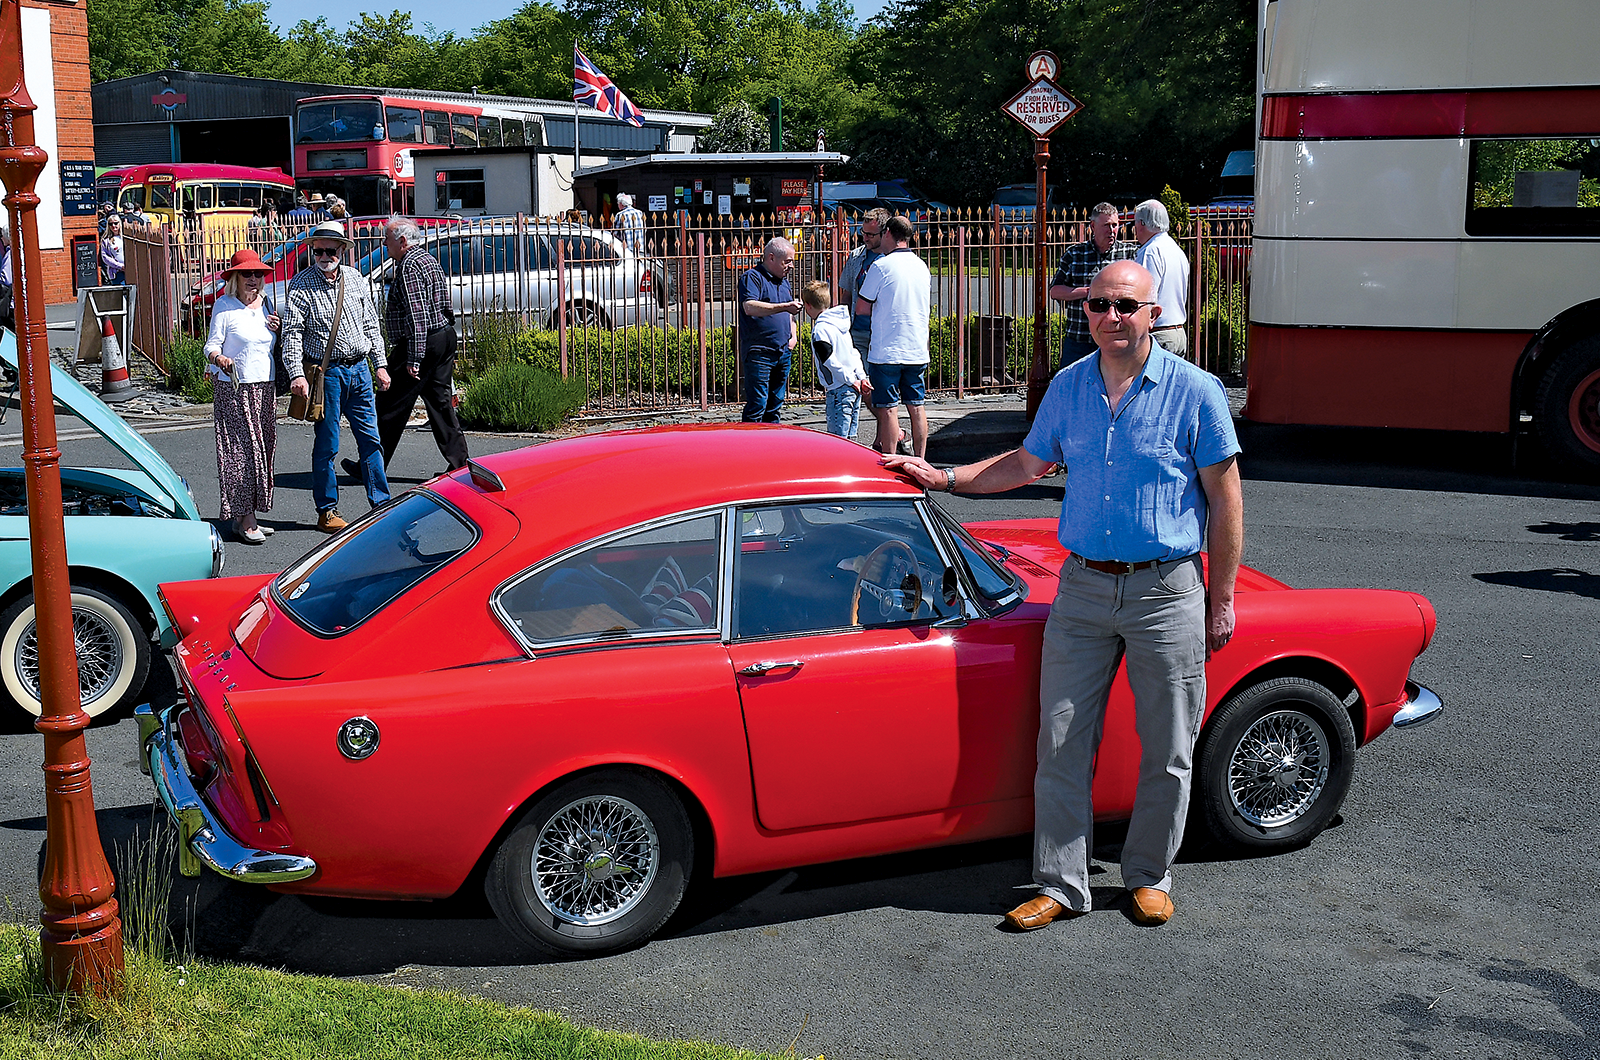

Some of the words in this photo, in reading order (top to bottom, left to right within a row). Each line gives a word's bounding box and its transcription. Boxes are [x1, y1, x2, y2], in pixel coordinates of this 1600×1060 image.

[1035, 56, 1050, 74] A
[1016, 101, 1070, 113] RESERVED
[1024, 114, 1037, 124] FOR
[1039, 114, 1060, 124] BUSES
